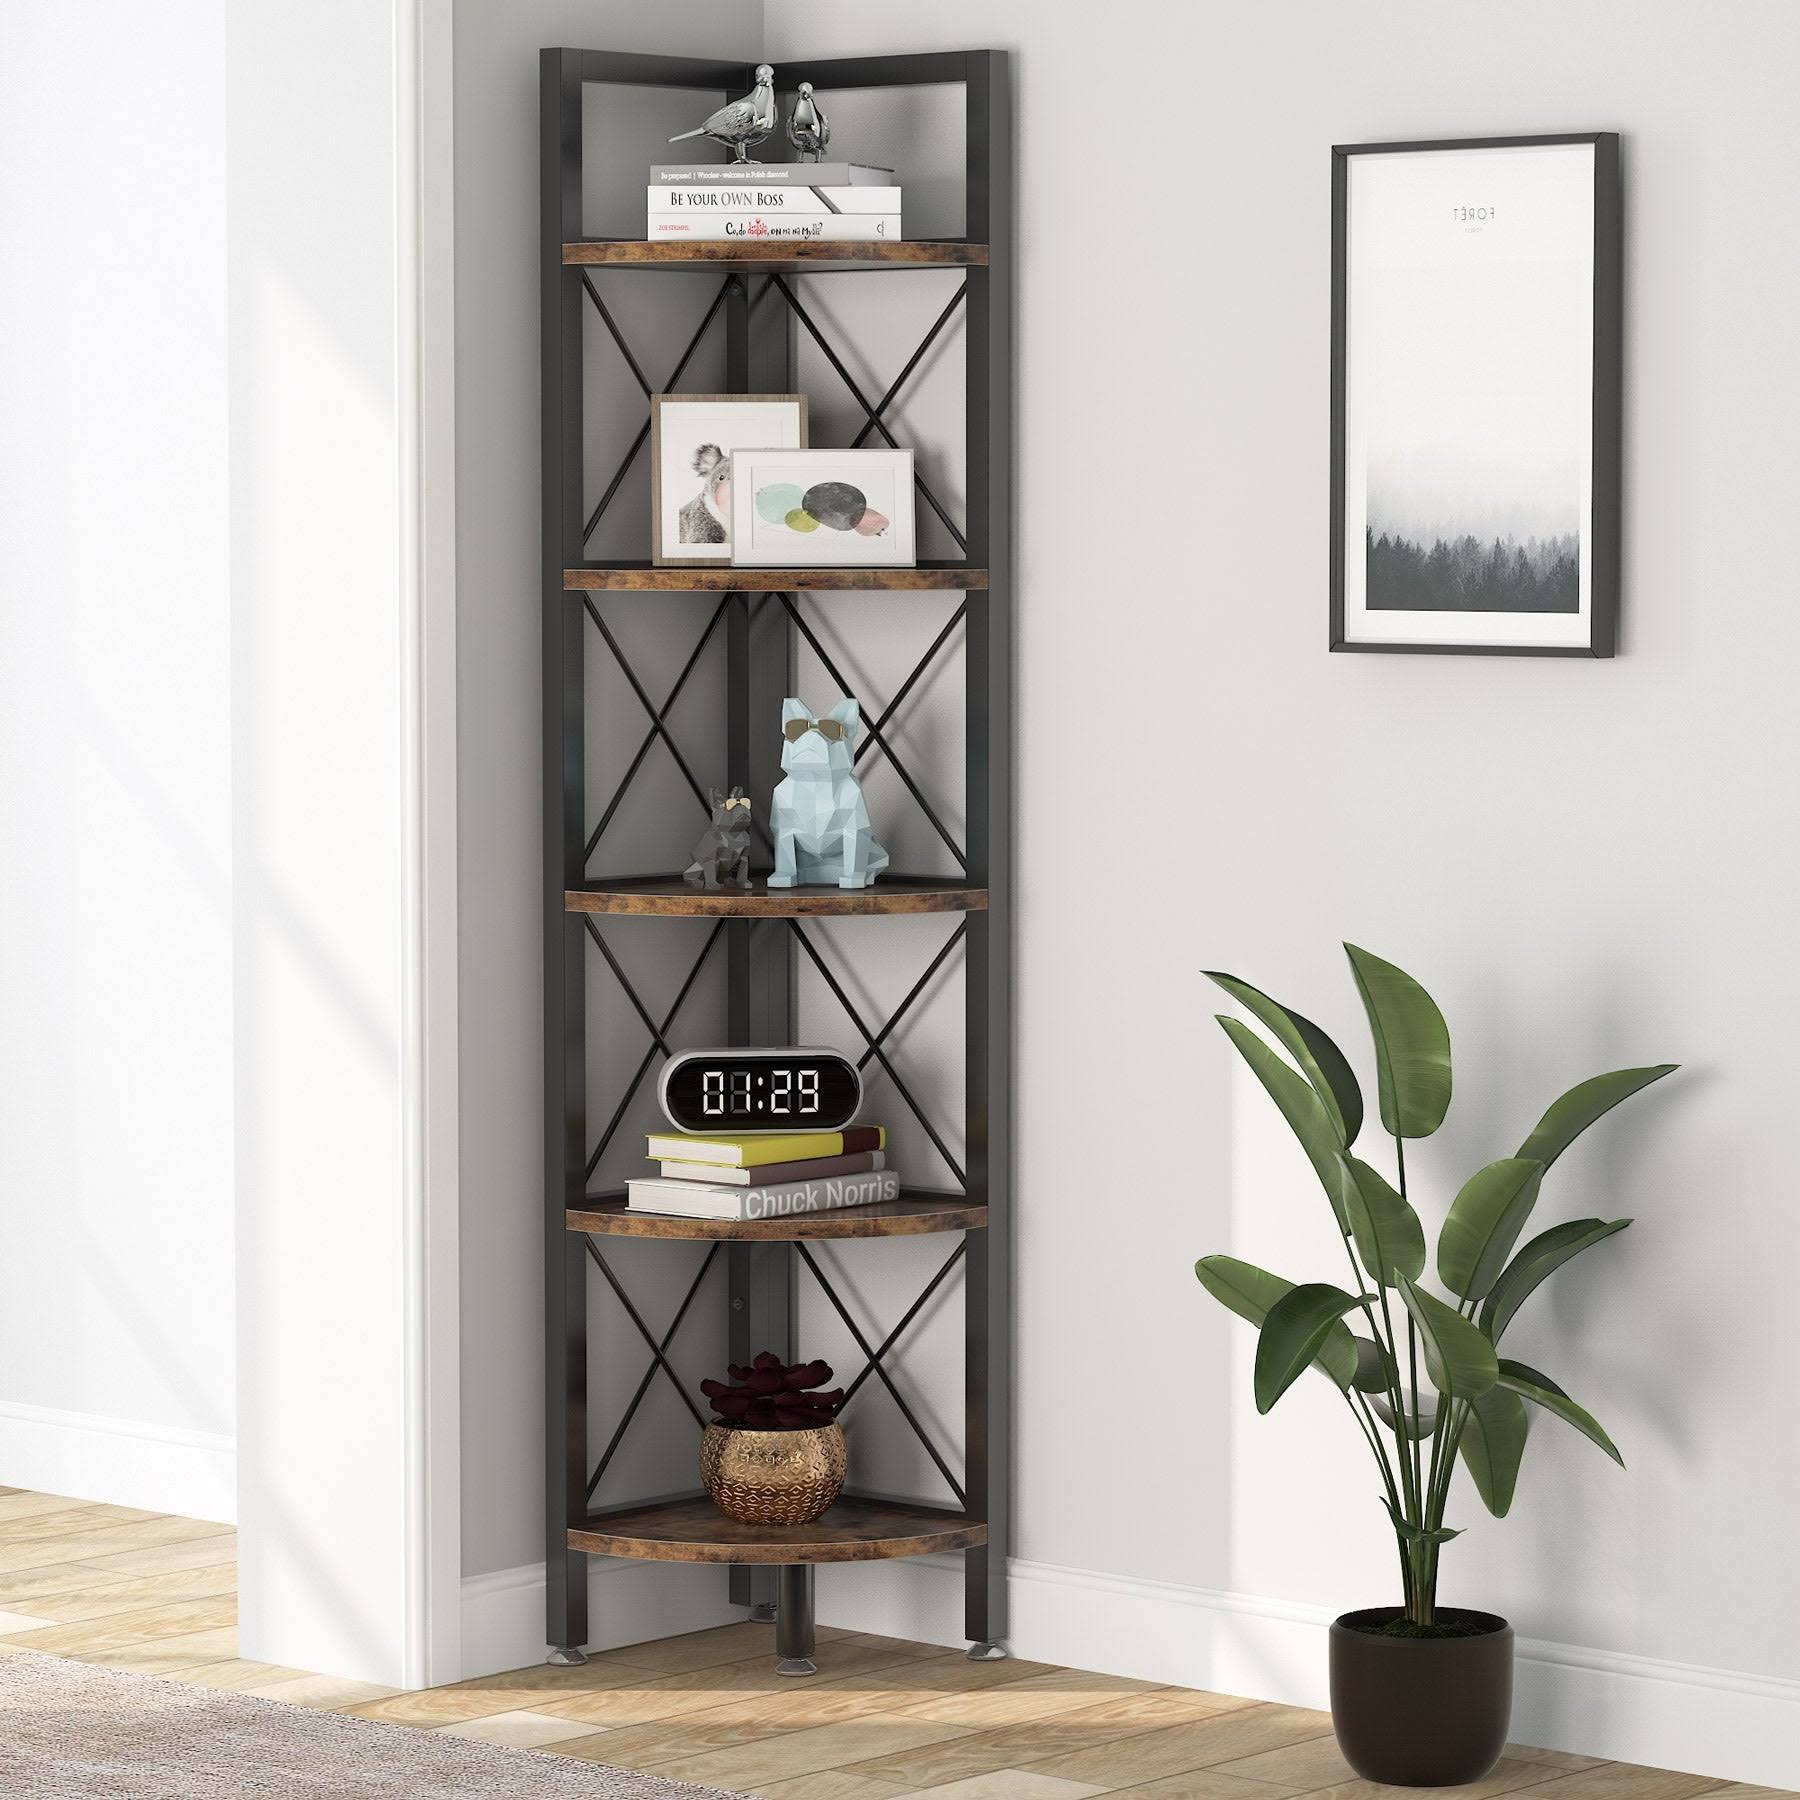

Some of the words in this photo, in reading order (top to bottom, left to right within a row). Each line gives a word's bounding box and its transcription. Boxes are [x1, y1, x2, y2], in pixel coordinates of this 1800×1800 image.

[687, 193, 719, 206] YOUR
[720, 191, 752, 206] OWN
[757, 192, 784, 206] BOSS
[703, 1069, 819, 1115] 01:29
[745, 1185, 819, 1219] Chuck
[826, 1175, 897, 1210] Norris
